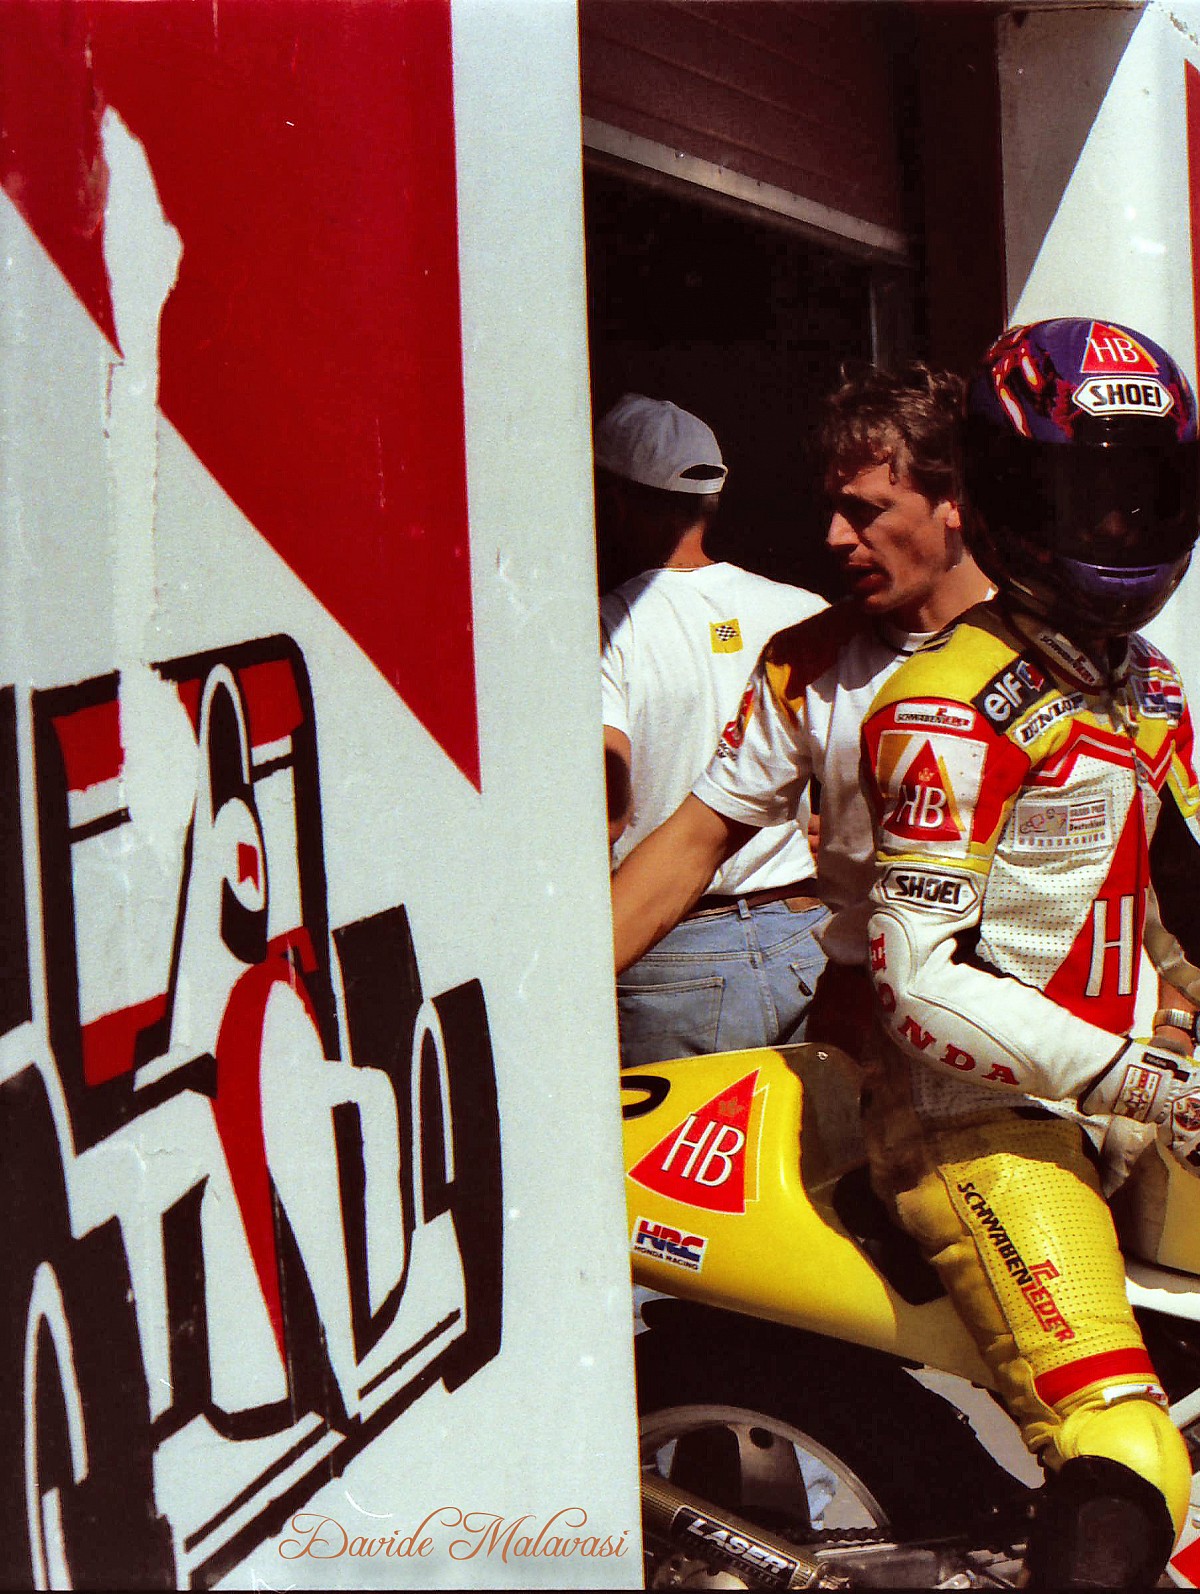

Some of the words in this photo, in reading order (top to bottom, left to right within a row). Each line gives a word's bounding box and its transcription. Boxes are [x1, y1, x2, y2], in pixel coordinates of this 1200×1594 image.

[1087, 337, 1139, 363] HB
[1089, 384, 1162, 407] SHOEI
[984, 672, 1022, 721] elf
[896, 785, 946, 828] HB
[895, 875, 961, 905] SHOEI
[871, 933, 1019, 1085] HONDA
[661, 1113, 745, 1188] HB
[634, 1246, 664, 1260] HONDA
[666, 1254, 699, 1271] RACING
[636, 1220, 704, 1261] HRC
[687, 1518, 789, 1574] LASER
